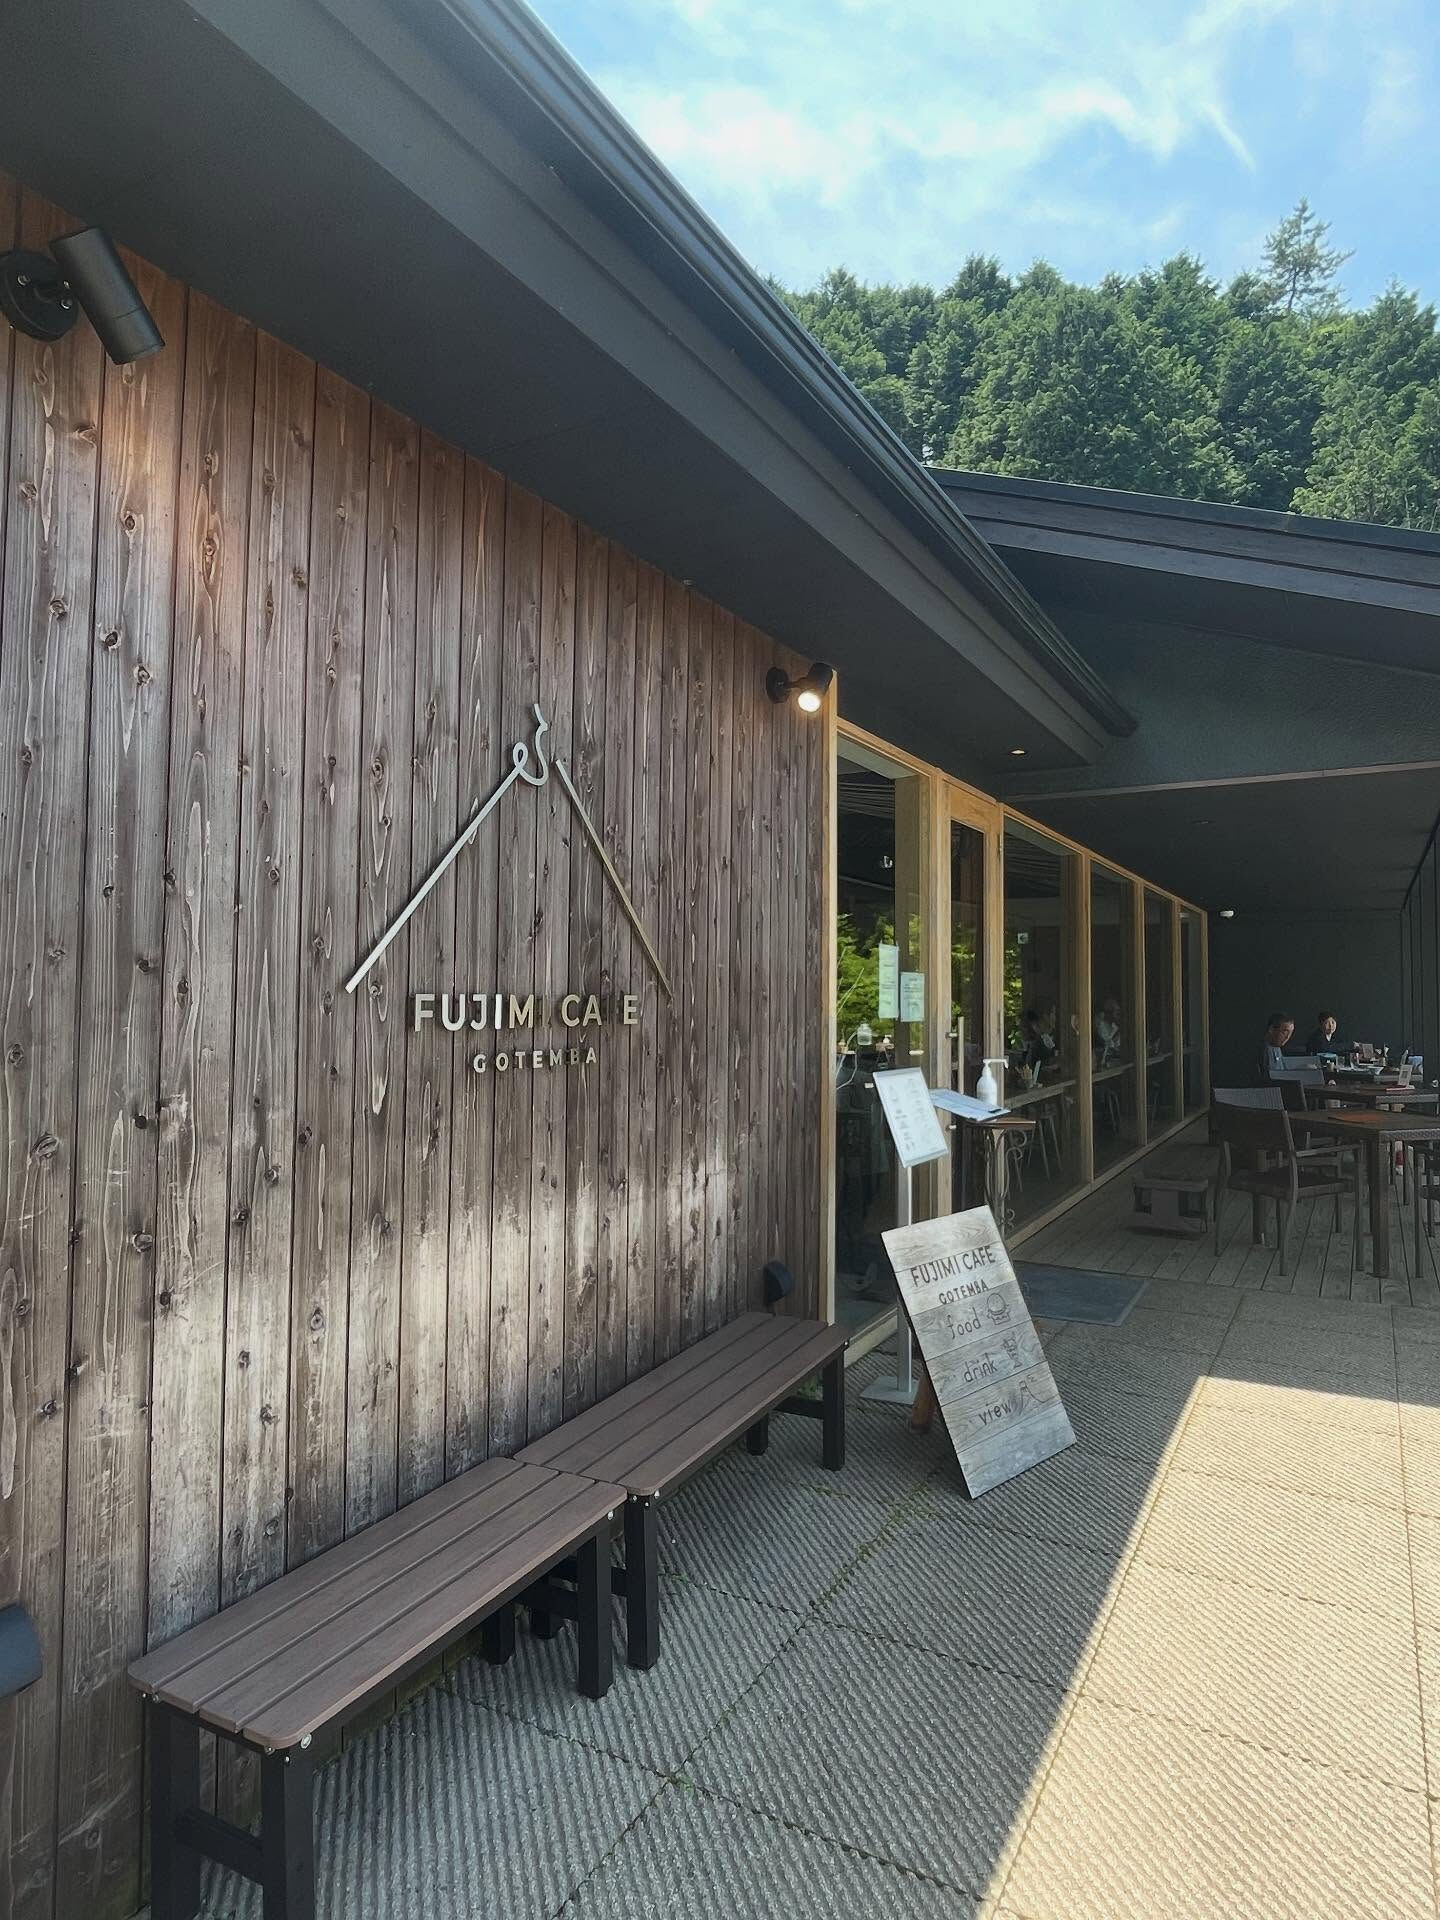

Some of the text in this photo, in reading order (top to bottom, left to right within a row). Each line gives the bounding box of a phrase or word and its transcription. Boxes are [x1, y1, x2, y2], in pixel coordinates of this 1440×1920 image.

[560, 993, 639, 1027] CAE
[473, 1047, 597, 1073] GOTEMBA
[910, 1245, 996, 1288] FUJIMI CAFE
[938, 1279, 989, 1305] GOTEMBA
[946, 1306, 981, 1339] food
[963, 1352, 998, 1383] drink
[978, 1402, 1012, 1426] view
